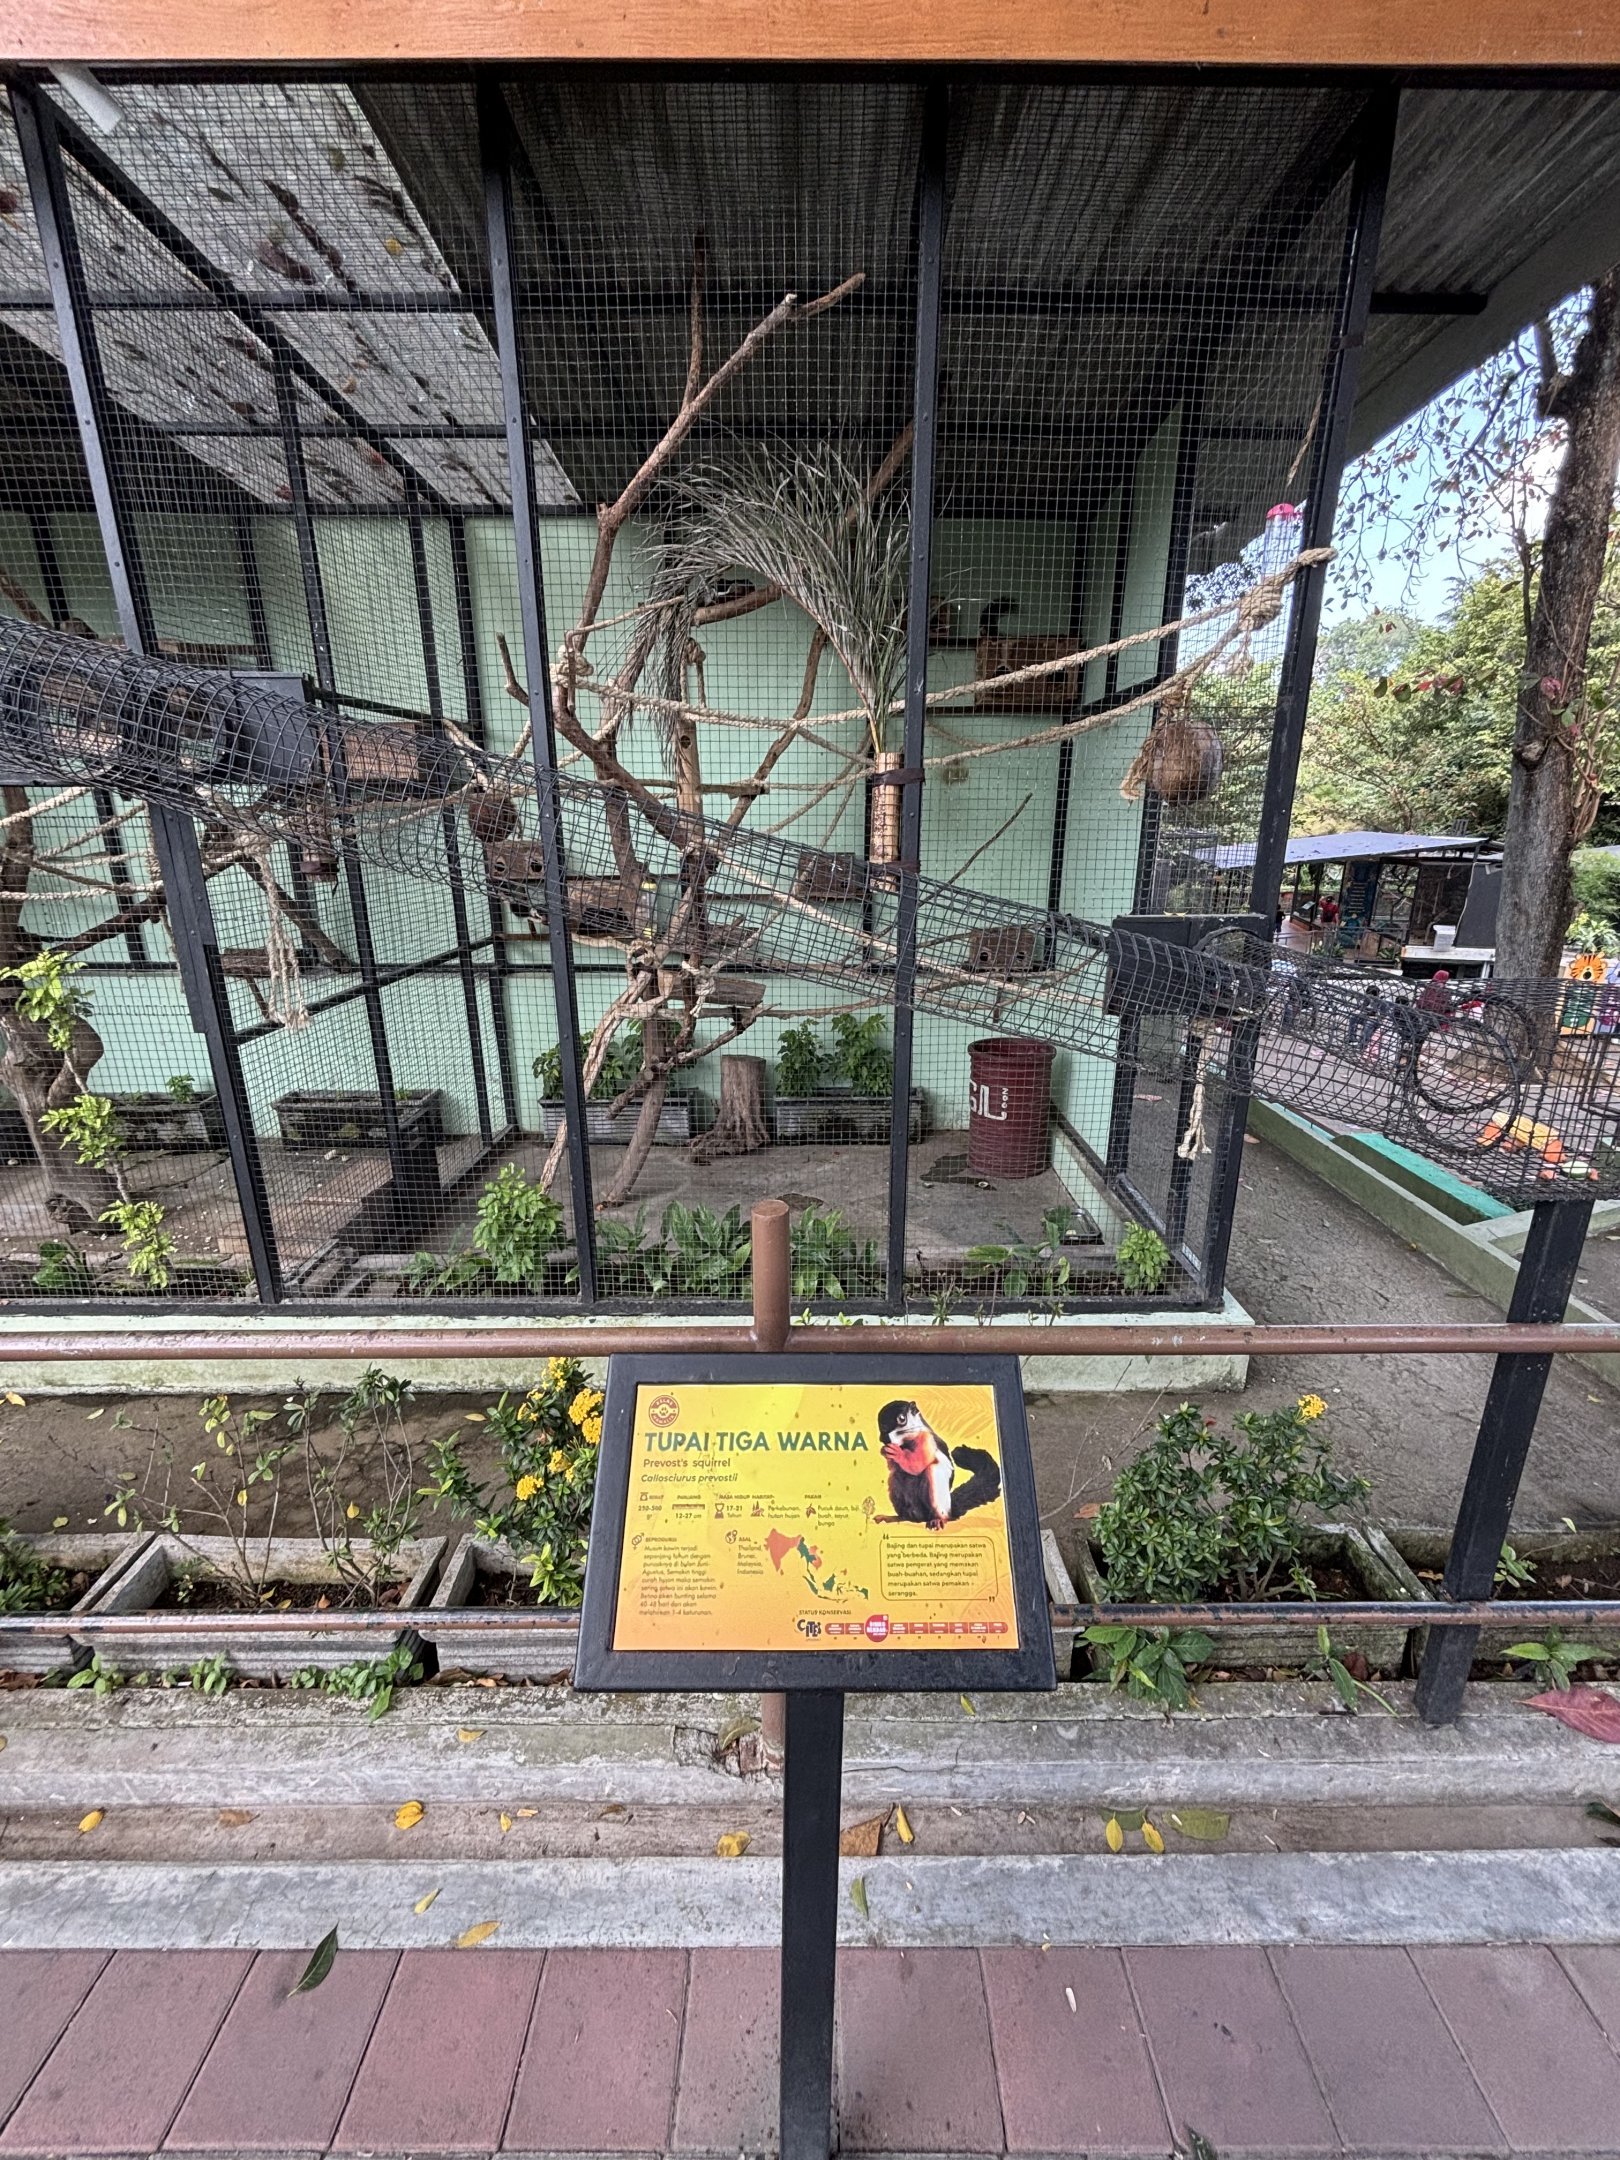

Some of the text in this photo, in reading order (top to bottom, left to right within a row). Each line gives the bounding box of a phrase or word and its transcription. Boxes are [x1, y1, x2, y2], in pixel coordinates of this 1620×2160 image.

[645, 1432, 868, 1452] TUPAI TIGA WARNA
[643, 1458, 731, 1470] Prevost's squirrel
[641, 1473, 738, 1484] Callosciurus prevostii
[886, 1542, 905, 1550] Bajing
[918, 1542, 934, 1550] tupai
[797, 1618, 822, 1638] CITES
